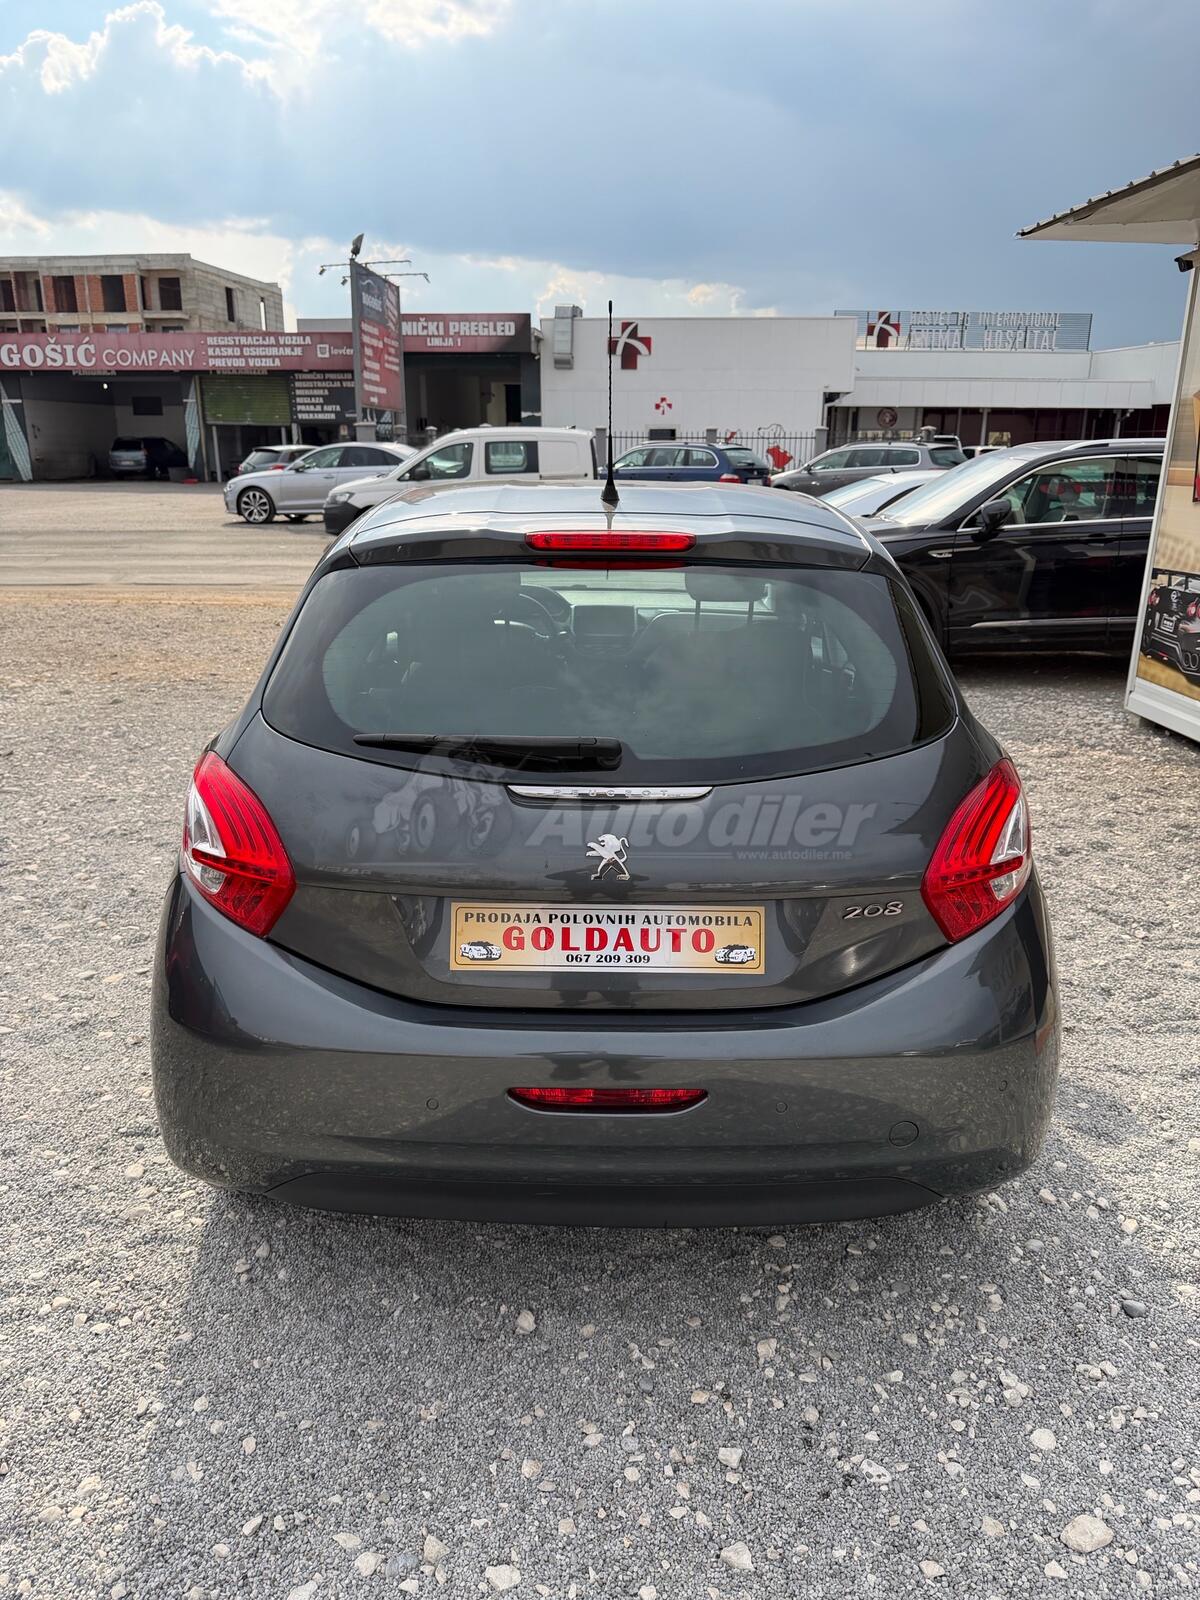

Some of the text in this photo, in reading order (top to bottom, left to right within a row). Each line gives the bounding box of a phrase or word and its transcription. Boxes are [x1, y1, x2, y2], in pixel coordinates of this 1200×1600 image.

[401, 317, 516, 336] NIČKI PREGLED
[979, 312, 1061, 327] INTERNATIONAL
[207, 336, 312, 345] REGISTRACIJA VOZILA
[427, 337, 461, 346] LINIJA 1
[984, 330, 1057, 350] HOSPITAL
[0, 336, 195, 367] GOŠIĆ COMPANY
[208, 347, 303, 356] KASKO OSIGURANJE
[208, 358, 281, 367] PREVOD VOZILA
[844, 901, 903, 919] 208
[464, 912, 753, 927] PRODAJA POLOVNIH AUTOMOBILA
[502, 925, 715, 953] GOLDAUTO
[566, 954, 650, 963] 067 209 309
